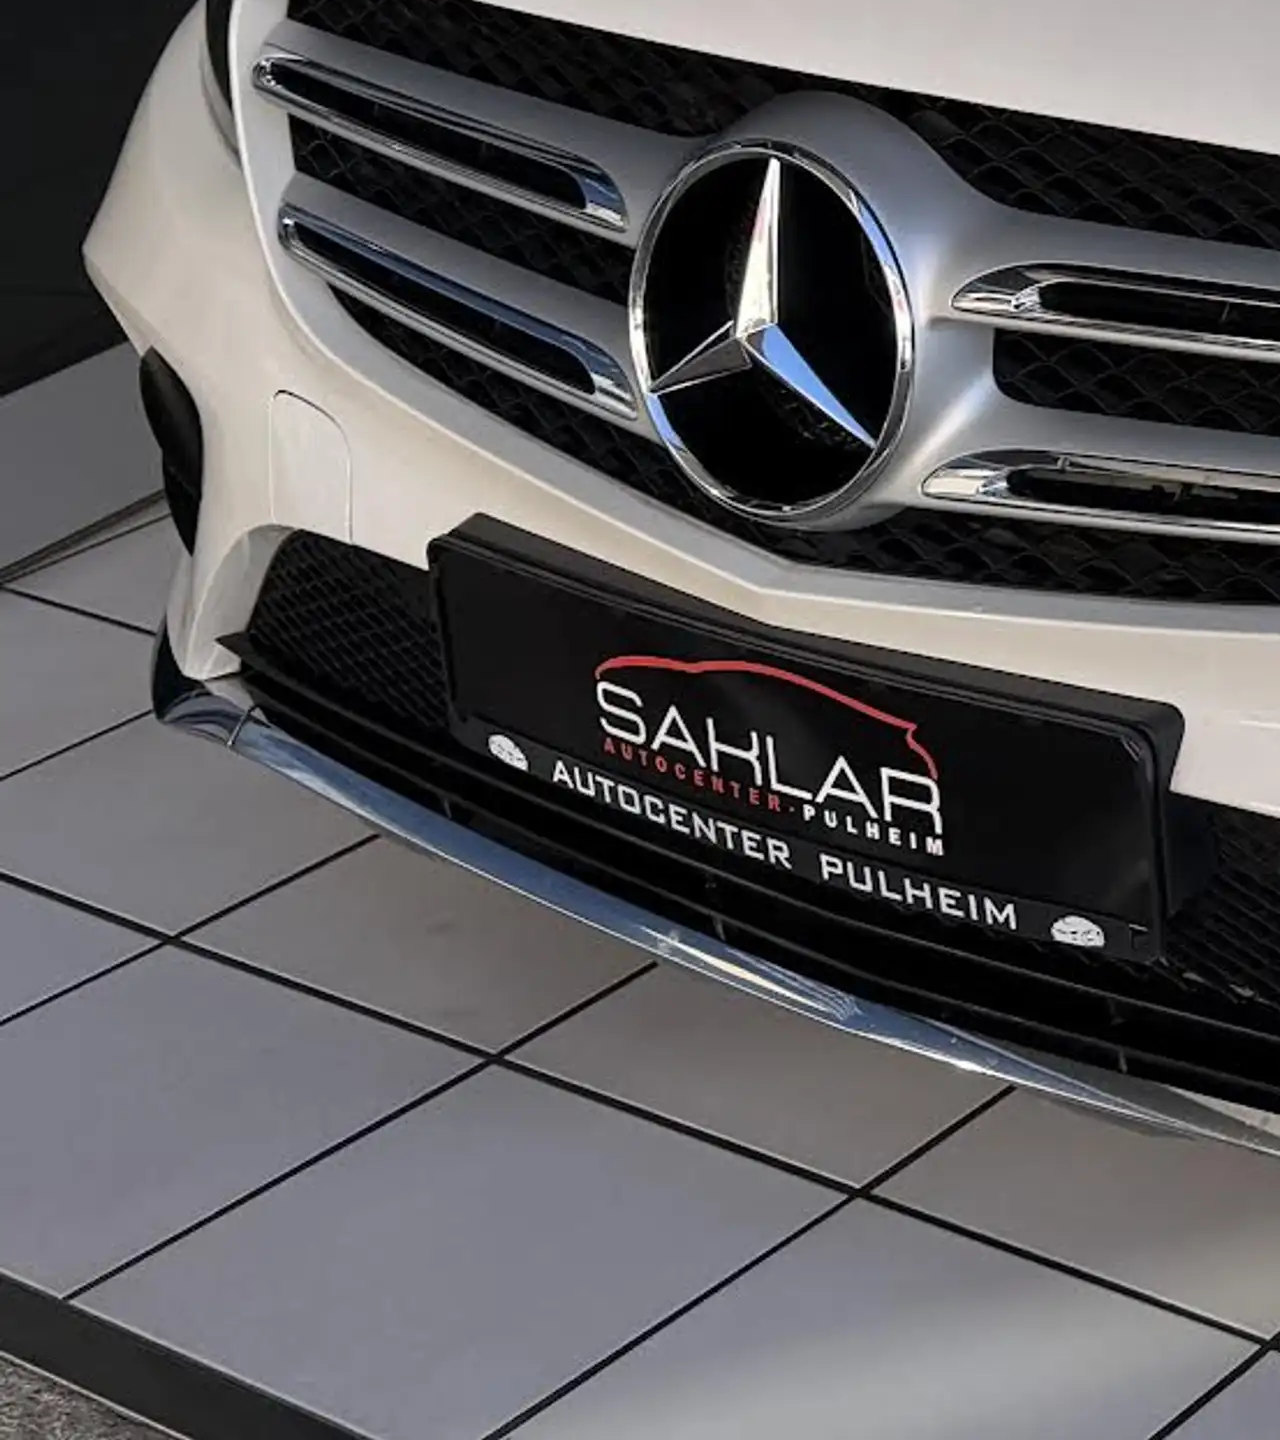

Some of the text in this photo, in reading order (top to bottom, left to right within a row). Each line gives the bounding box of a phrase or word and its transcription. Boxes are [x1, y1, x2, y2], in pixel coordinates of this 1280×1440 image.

[596, 680, 943, 835] SAHLAR
[552, 760, 1018, 931] AUTOCENTER PULHEIM
